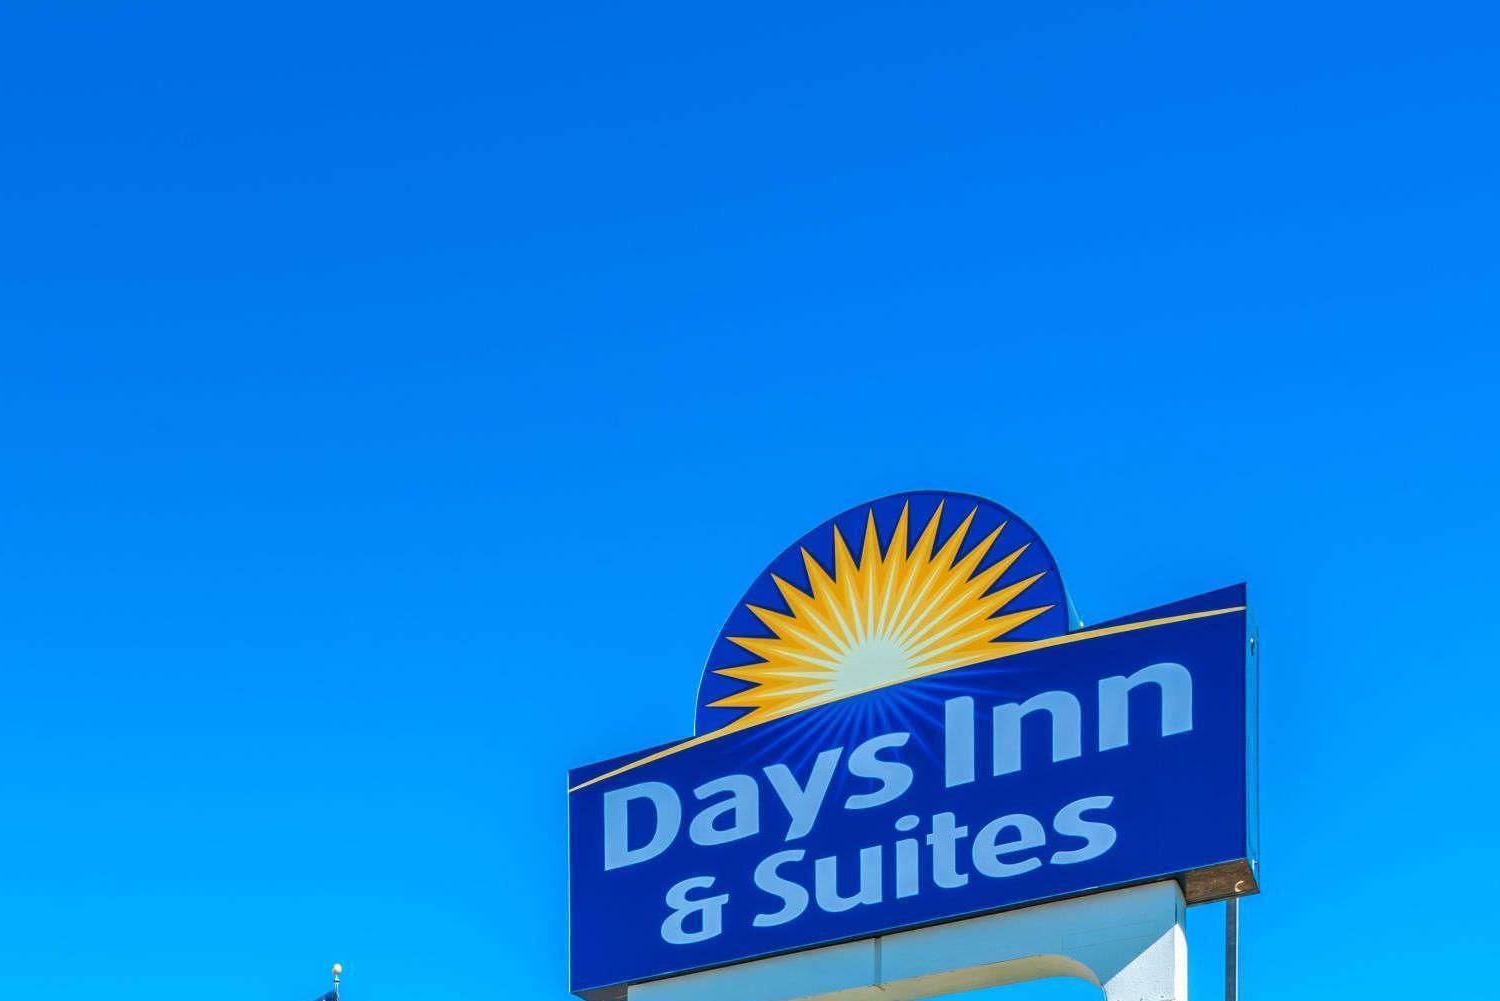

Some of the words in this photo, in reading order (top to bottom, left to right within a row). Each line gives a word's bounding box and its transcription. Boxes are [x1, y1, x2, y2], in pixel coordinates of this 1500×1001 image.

[603, 732, 914, 871] Days
[945, 662, 1193, 788] Inn
[660, 876, 729, 945] &
[752, 795, 1117, 927] Suites
